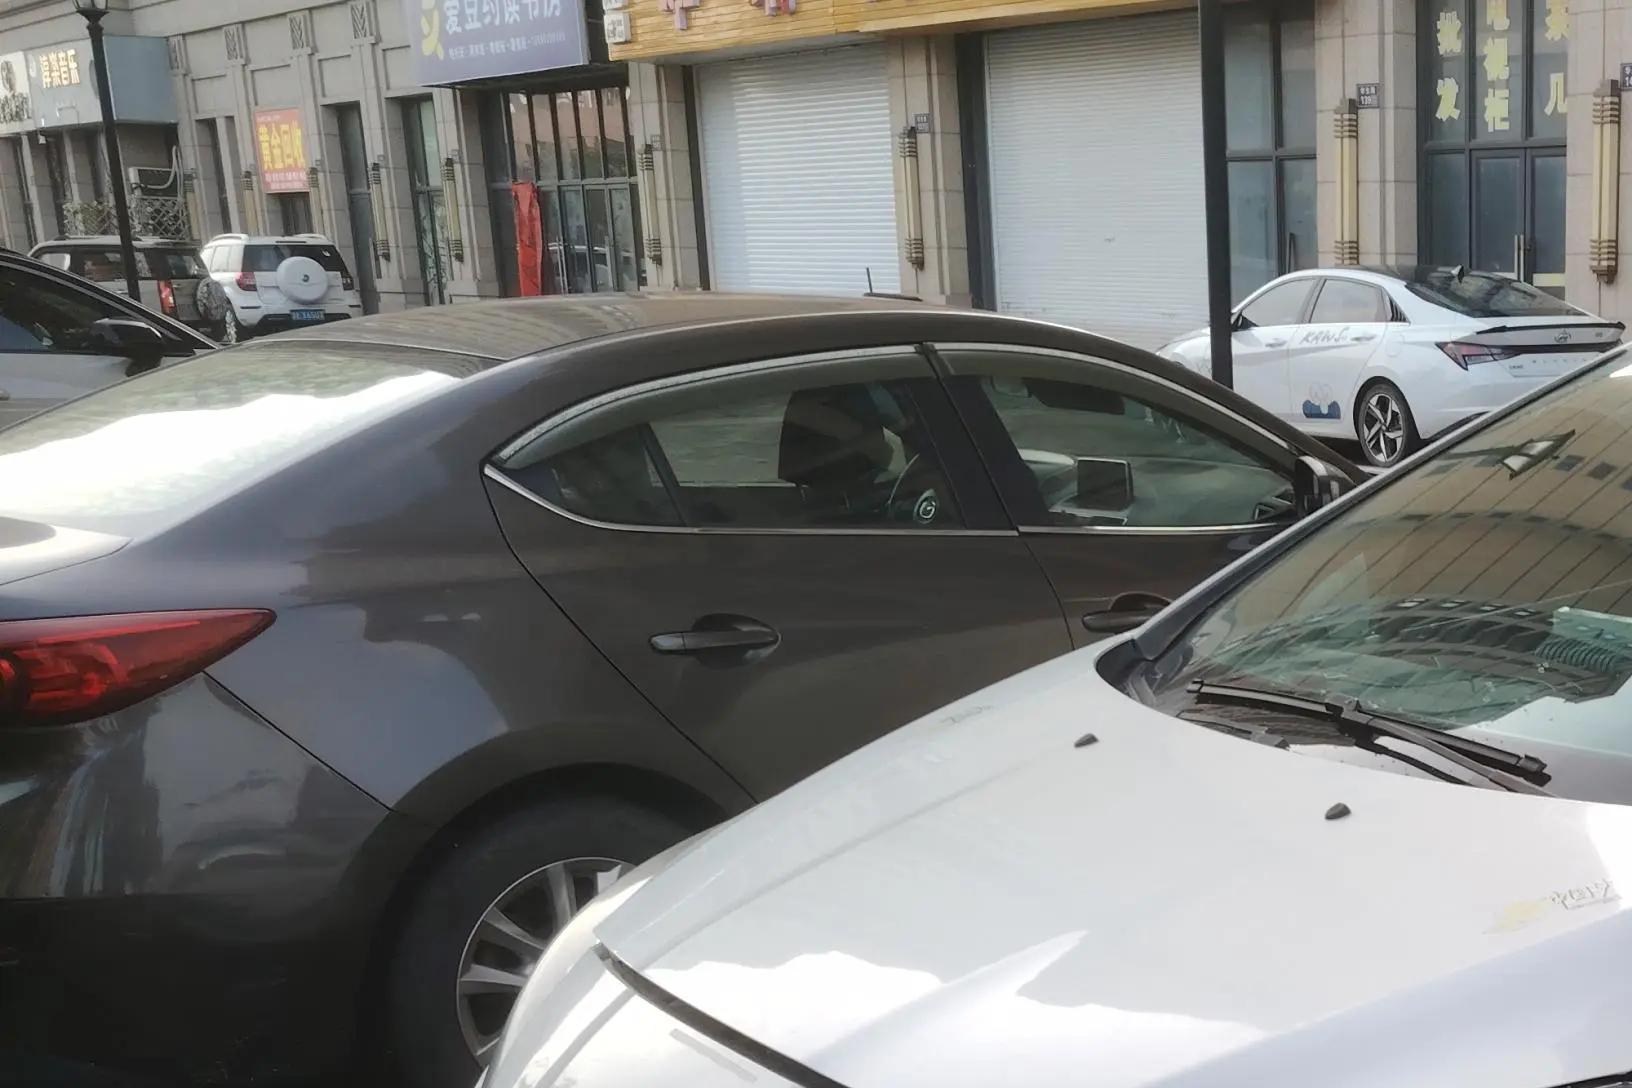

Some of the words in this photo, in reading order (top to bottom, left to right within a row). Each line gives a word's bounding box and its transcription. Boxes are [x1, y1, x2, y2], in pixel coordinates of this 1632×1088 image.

[1436, 8, 1461, 121] 批发
[1483, 0, 1510, 132] 电视柜
[258, 122, 304, 170] 黄金回收
